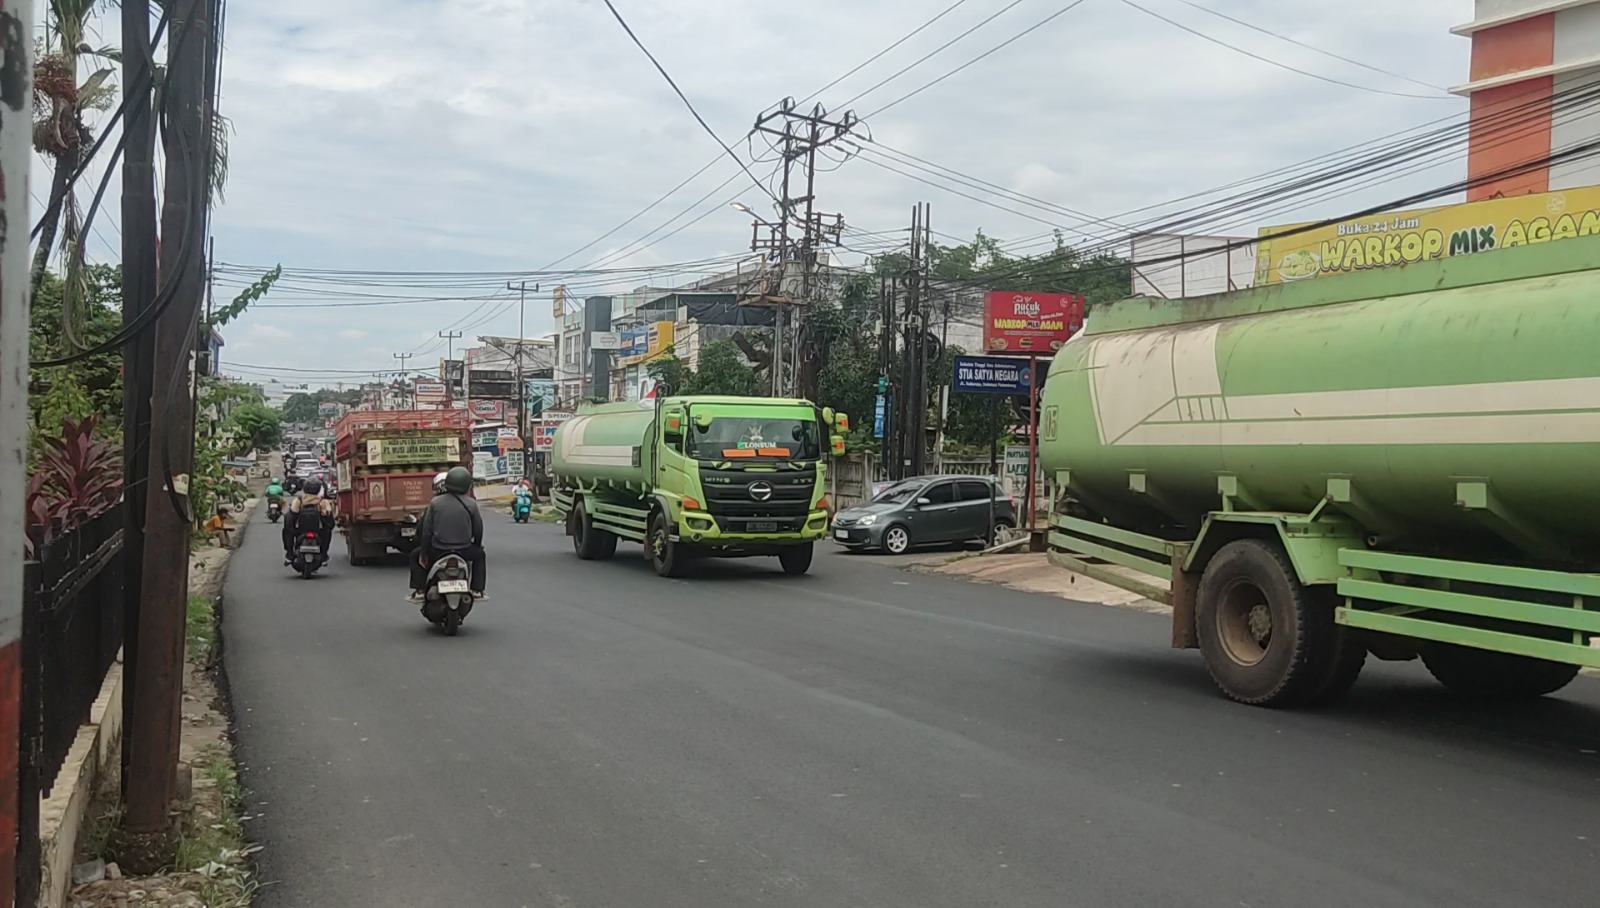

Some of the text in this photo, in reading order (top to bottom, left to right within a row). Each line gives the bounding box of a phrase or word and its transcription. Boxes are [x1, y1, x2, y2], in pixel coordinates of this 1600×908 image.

[1337, 217, 1419, 236] Buka 24 Jam
[1319, 210, 1600, 272] WARKOP MIX AGAM
[1014, 301, 1040, 315] pucuk
[994, 319, 1027, 330] WARKOP
[1040, 321, 1064, 331] AGAM
[959, 368, 1018, 382] STIA SATYA NEGARA
